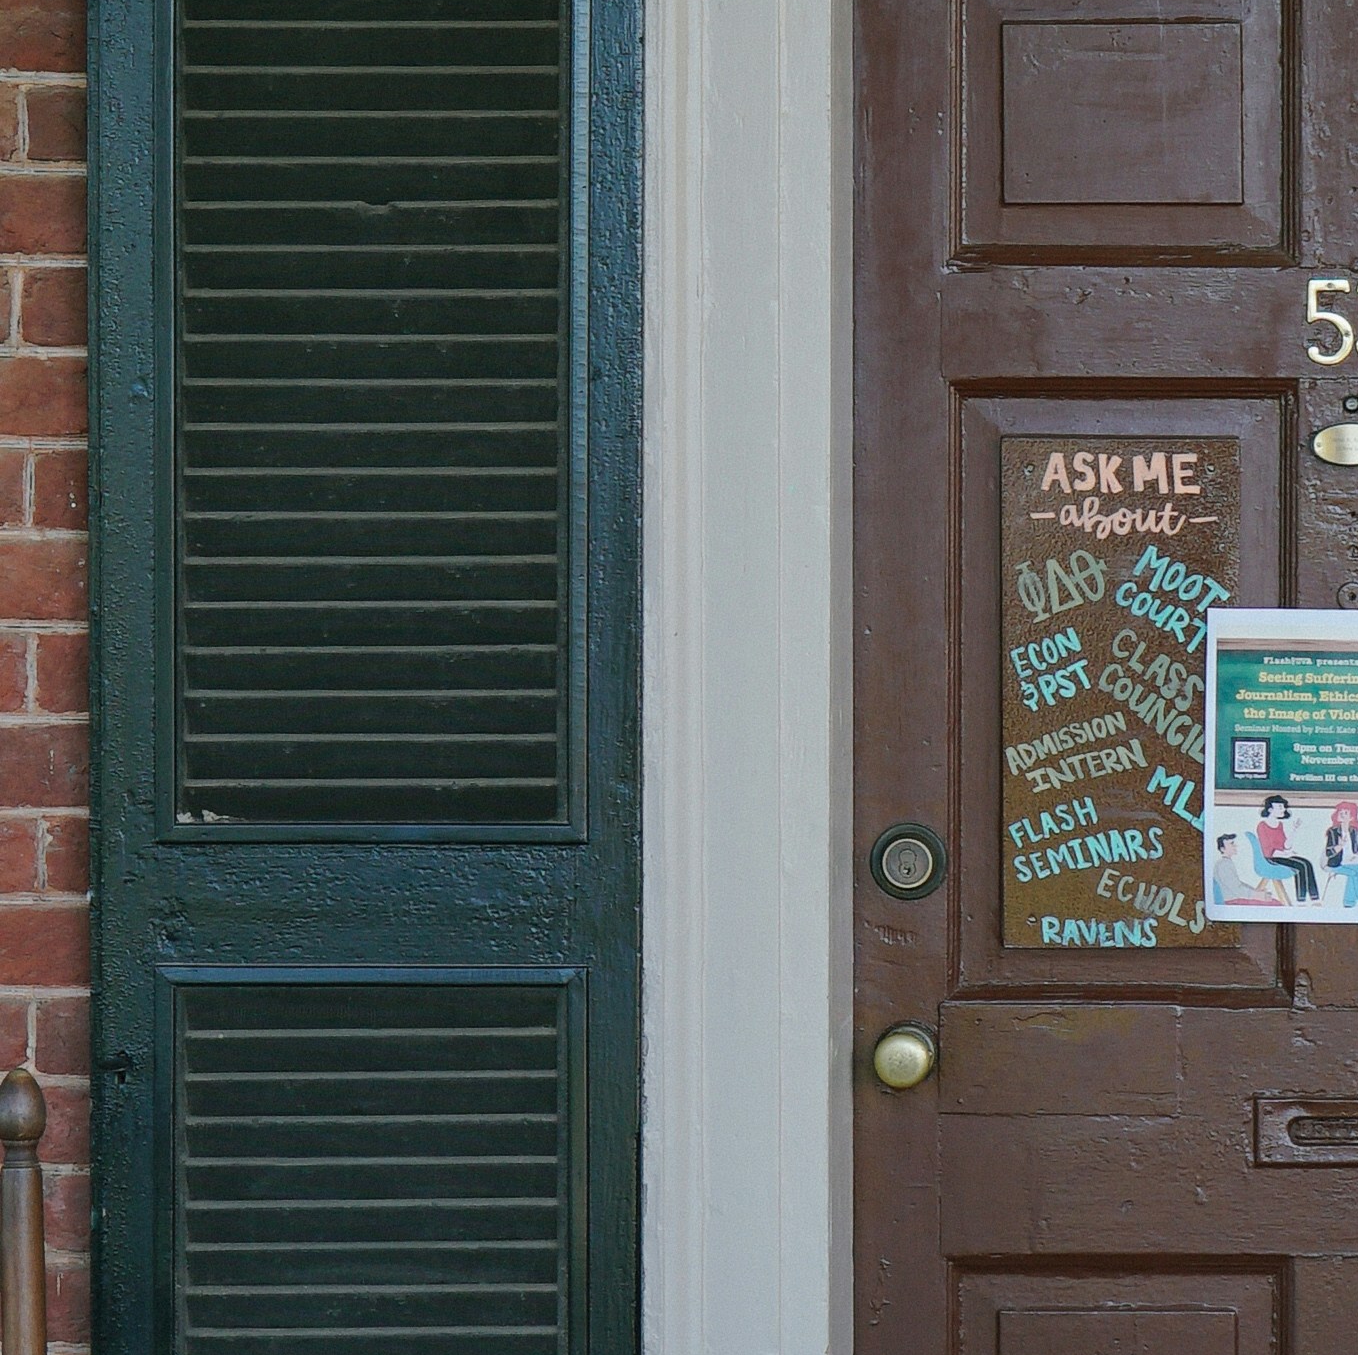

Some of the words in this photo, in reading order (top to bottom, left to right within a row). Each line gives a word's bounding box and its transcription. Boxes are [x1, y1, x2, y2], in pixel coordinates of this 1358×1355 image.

[1040, 452, 1124, 495] ASK
[1133, 452, 1202, 495] ME
[1132, 545, 1231, 614] MOOT
[1114, 582, 1207, 655] COURT
[1010, 627, 1083, 680] ECON
[1111, 628, 1206, 712] CLASS
[1258, 671, 1303, 686] Seeing
[1097, 662, 1207, 771] COUNCIL
[1236, 689, 1317, 704] Journalism,
[1243, 707, 1266, 719] the
[1268, 708, 1310, 722] Image
[1312, 709, 1328, 720] of
[1005, 711, 1127, 776] ADMISSION
[1025, 739, 1149, 795] INTERN
[1300, 755, 1356, 765] November
[1318, 745, 1333, 753] on
[1008, 796, 1099, 849] FLASH
[1013, 827, 1164, 884] SEMINARS
[1096, 868, 1207, 936] ECHOLS
[1040, 915, 1158, 948] RAVENS
